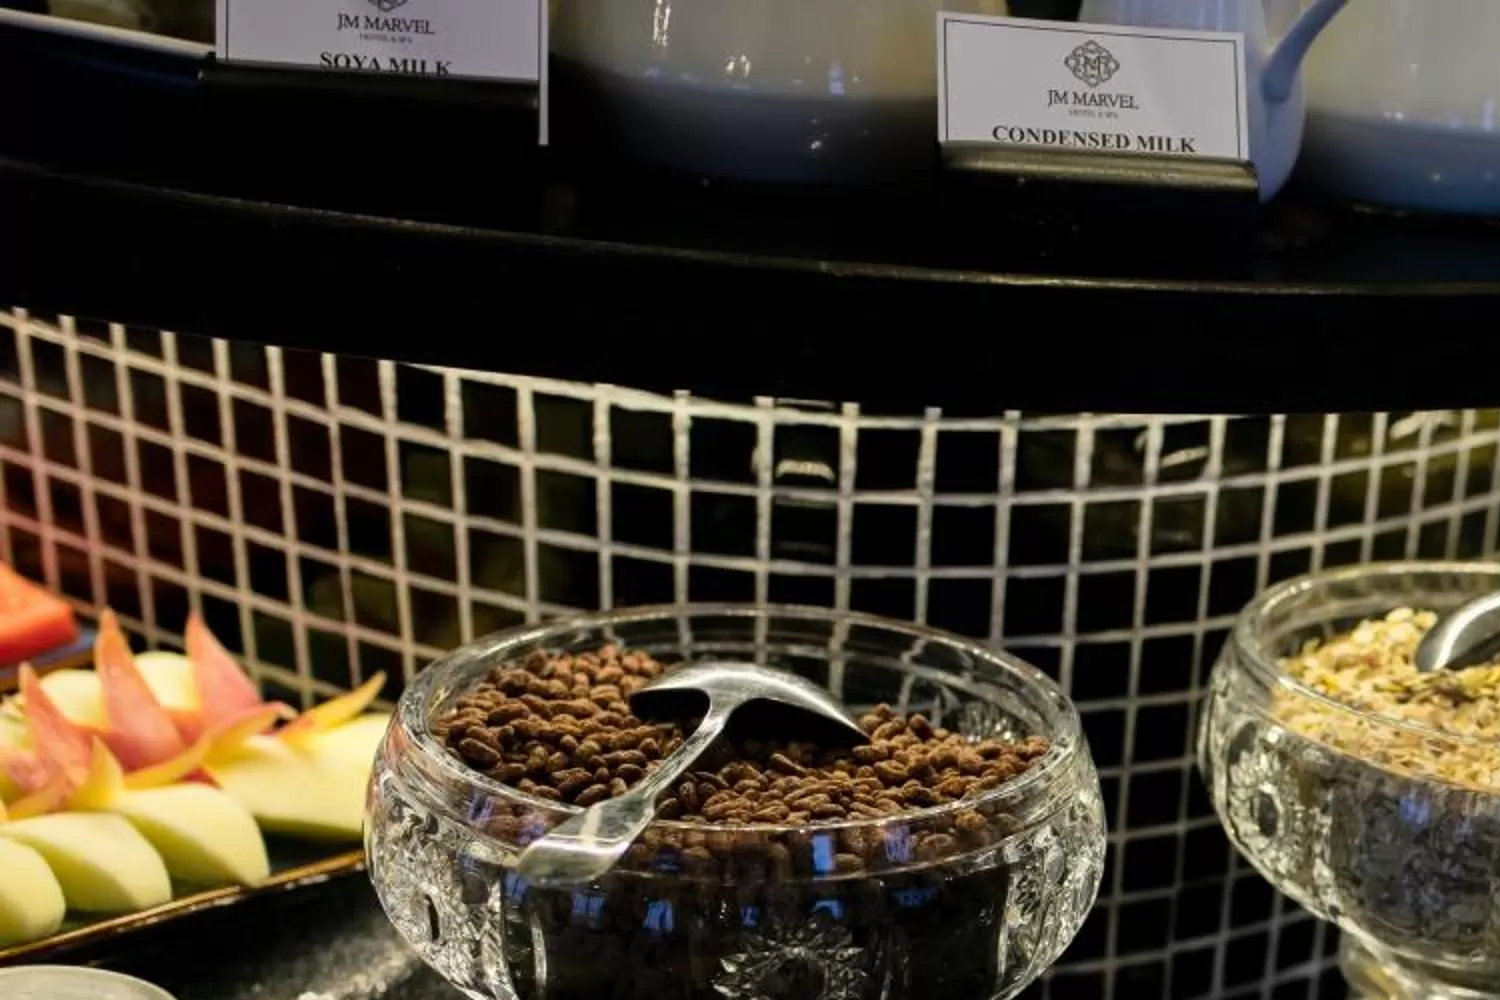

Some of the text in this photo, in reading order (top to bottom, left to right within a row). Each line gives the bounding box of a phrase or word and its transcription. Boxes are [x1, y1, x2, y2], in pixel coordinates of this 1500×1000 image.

[337, 13, 435, 35] JM MARVEL
[320, 52, 452, 76] SOYA MILK
[1047, 90, 1139, 109] JM MARVEL
[992, 125, 1196, 153] CONDENSED MILK
